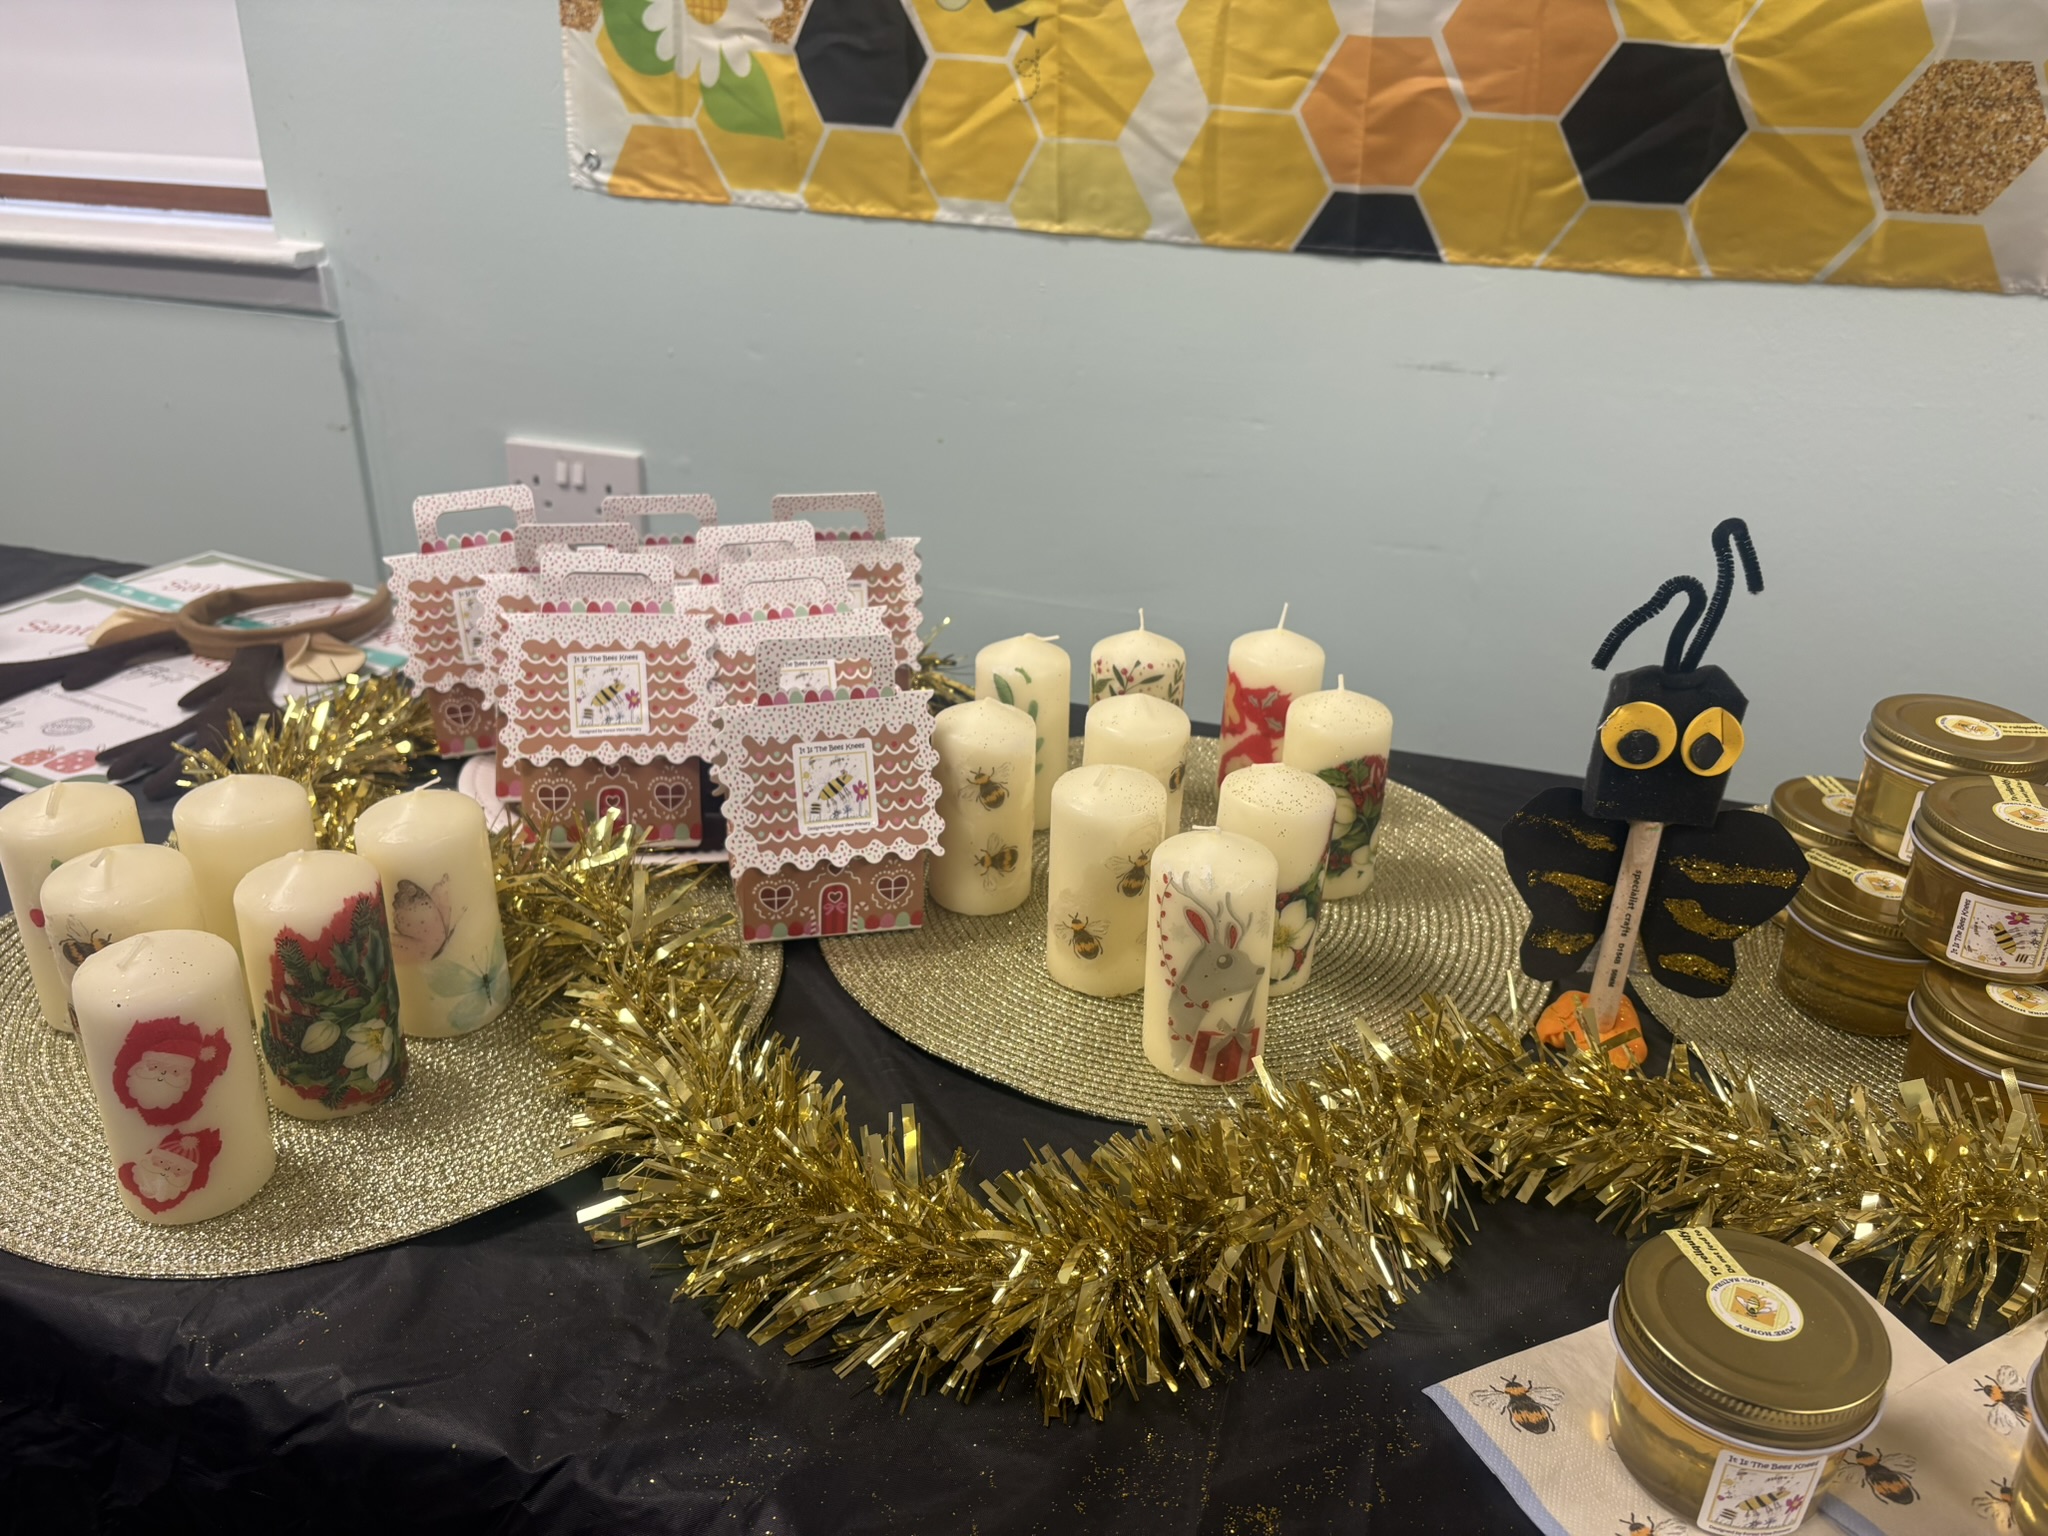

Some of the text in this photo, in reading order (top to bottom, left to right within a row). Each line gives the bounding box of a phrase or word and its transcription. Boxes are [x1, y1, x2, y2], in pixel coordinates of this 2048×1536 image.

[619, 653, 638, 661] Knees
[828, 744, 844, 752] Bees
[845, 742, 866, 750] Knees
[1628, 869, 1642, 910] specialist
[1960, 898, 1971, 917] Knees
[1620, 913, 1632, 937] crafts
[1956, 916, 1966, 931] Bees
[1954, 930, 1963, 942] The
[1950, 947, 1958, 955] It
[1699, 1237, 1718, 1251] feed
[1713, 1252, 1727, 1263] not
[1710, 1265, 1722, 1277] To
[1725, 1264, 1736, 1273] Do
[1711, 1277, 1765, 1292] 100% NATURAL
[1735, 1323, 1796, 1337] PURE HONEY
[1750, 1461, 1770, 1469] The
[1771, 1462, 1793, 1470] Bees
[1794, 1460, 1820, 1470] Knees
